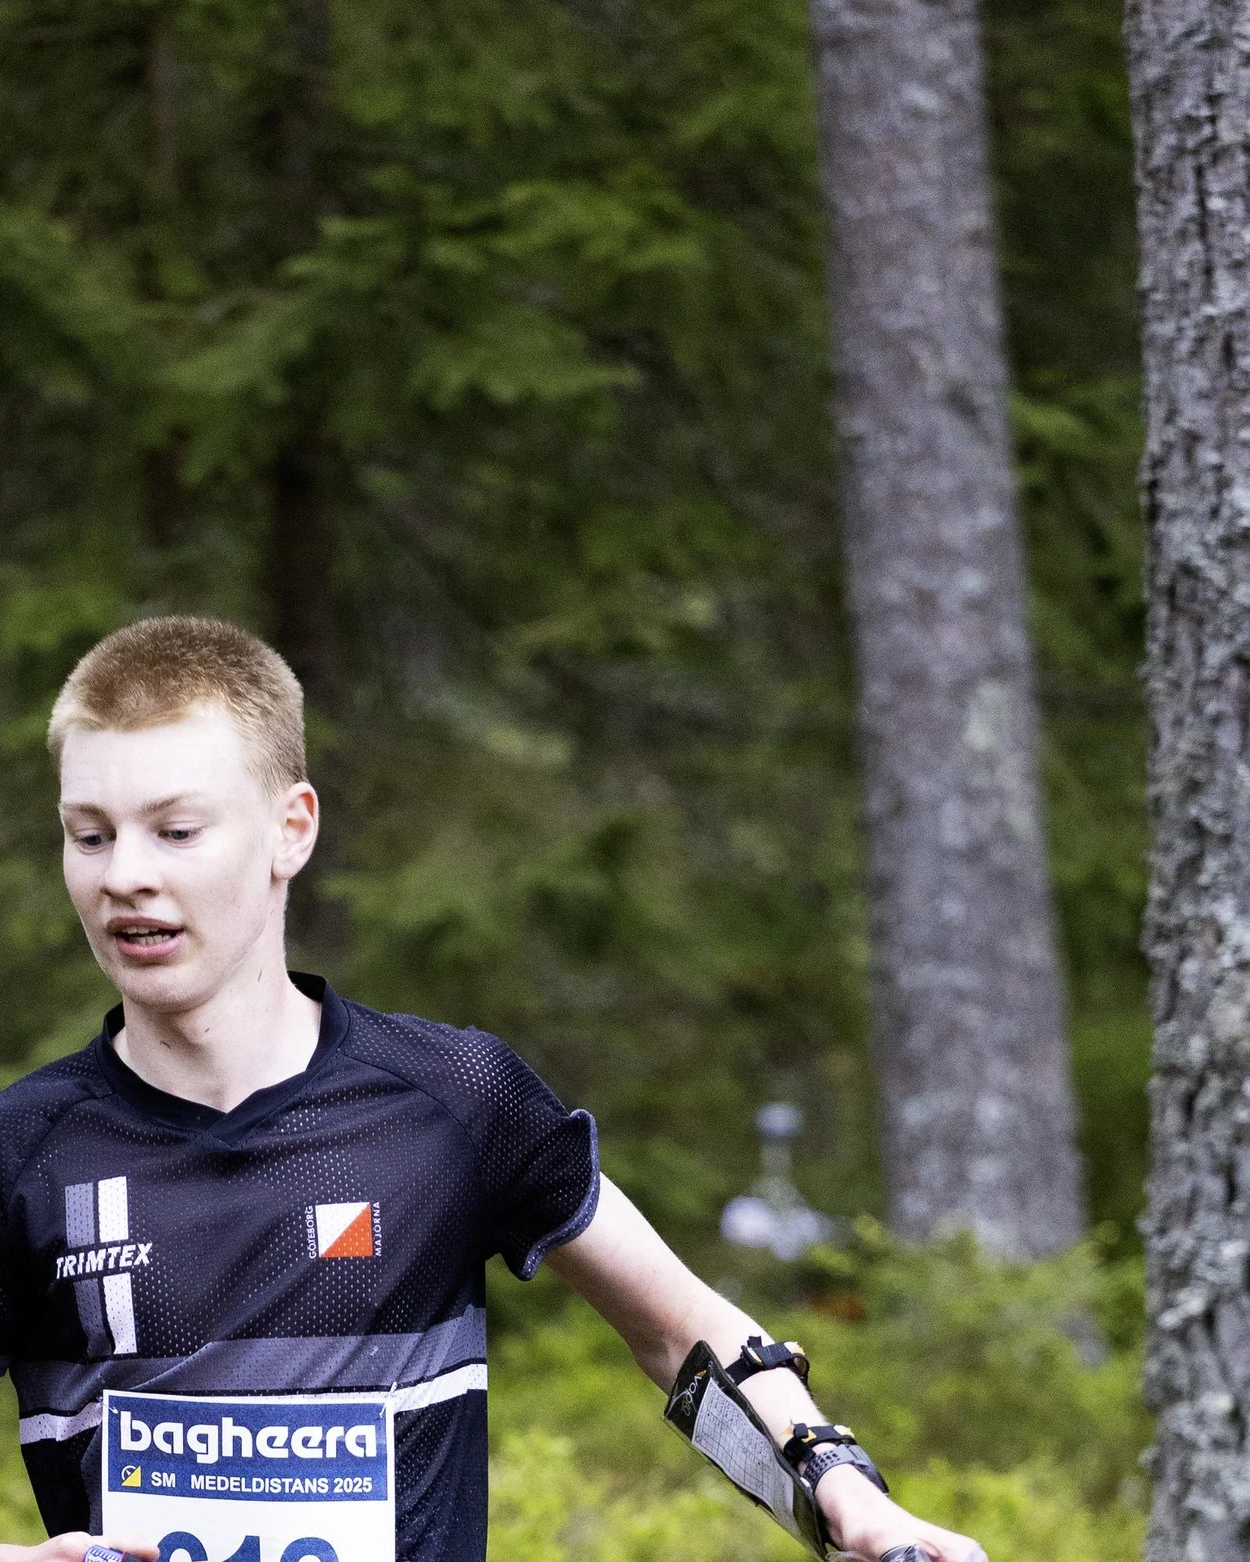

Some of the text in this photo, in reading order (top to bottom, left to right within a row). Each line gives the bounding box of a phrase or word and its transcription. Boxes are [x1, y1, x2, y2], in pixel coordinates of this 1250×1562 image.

[372, 1201, 382, 1257] MAJORNA
[56, 1243, 153, 1279] TRIMTEX
[120, 1411, 377, 1464] bagheera
[151, 1471, 373, 1494] SM MEDELDISTANS 2025
